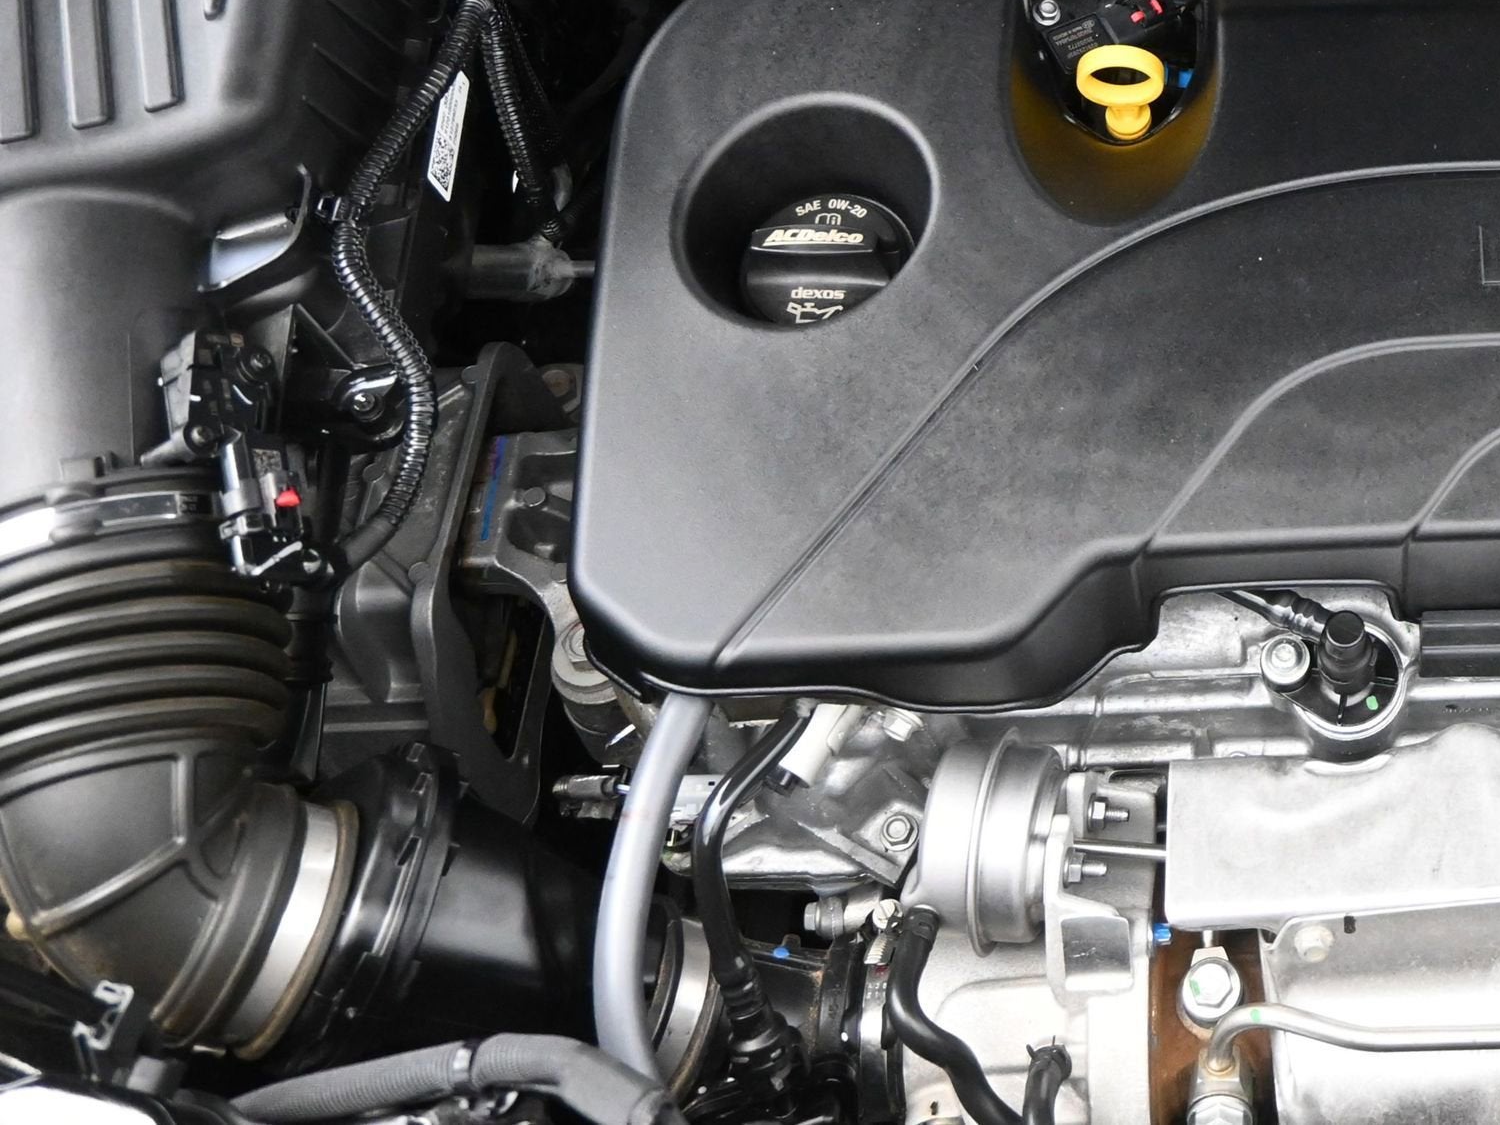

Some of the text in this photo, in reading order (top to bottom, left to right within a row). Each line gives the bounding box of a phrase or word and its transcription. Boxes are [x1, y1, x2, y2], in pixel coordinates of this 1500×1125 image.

[795, 198, 867, 218] SAE 0W-20
[764, 229, 864, 245] ACDelco
[791, 287, 847, 300] dexos
